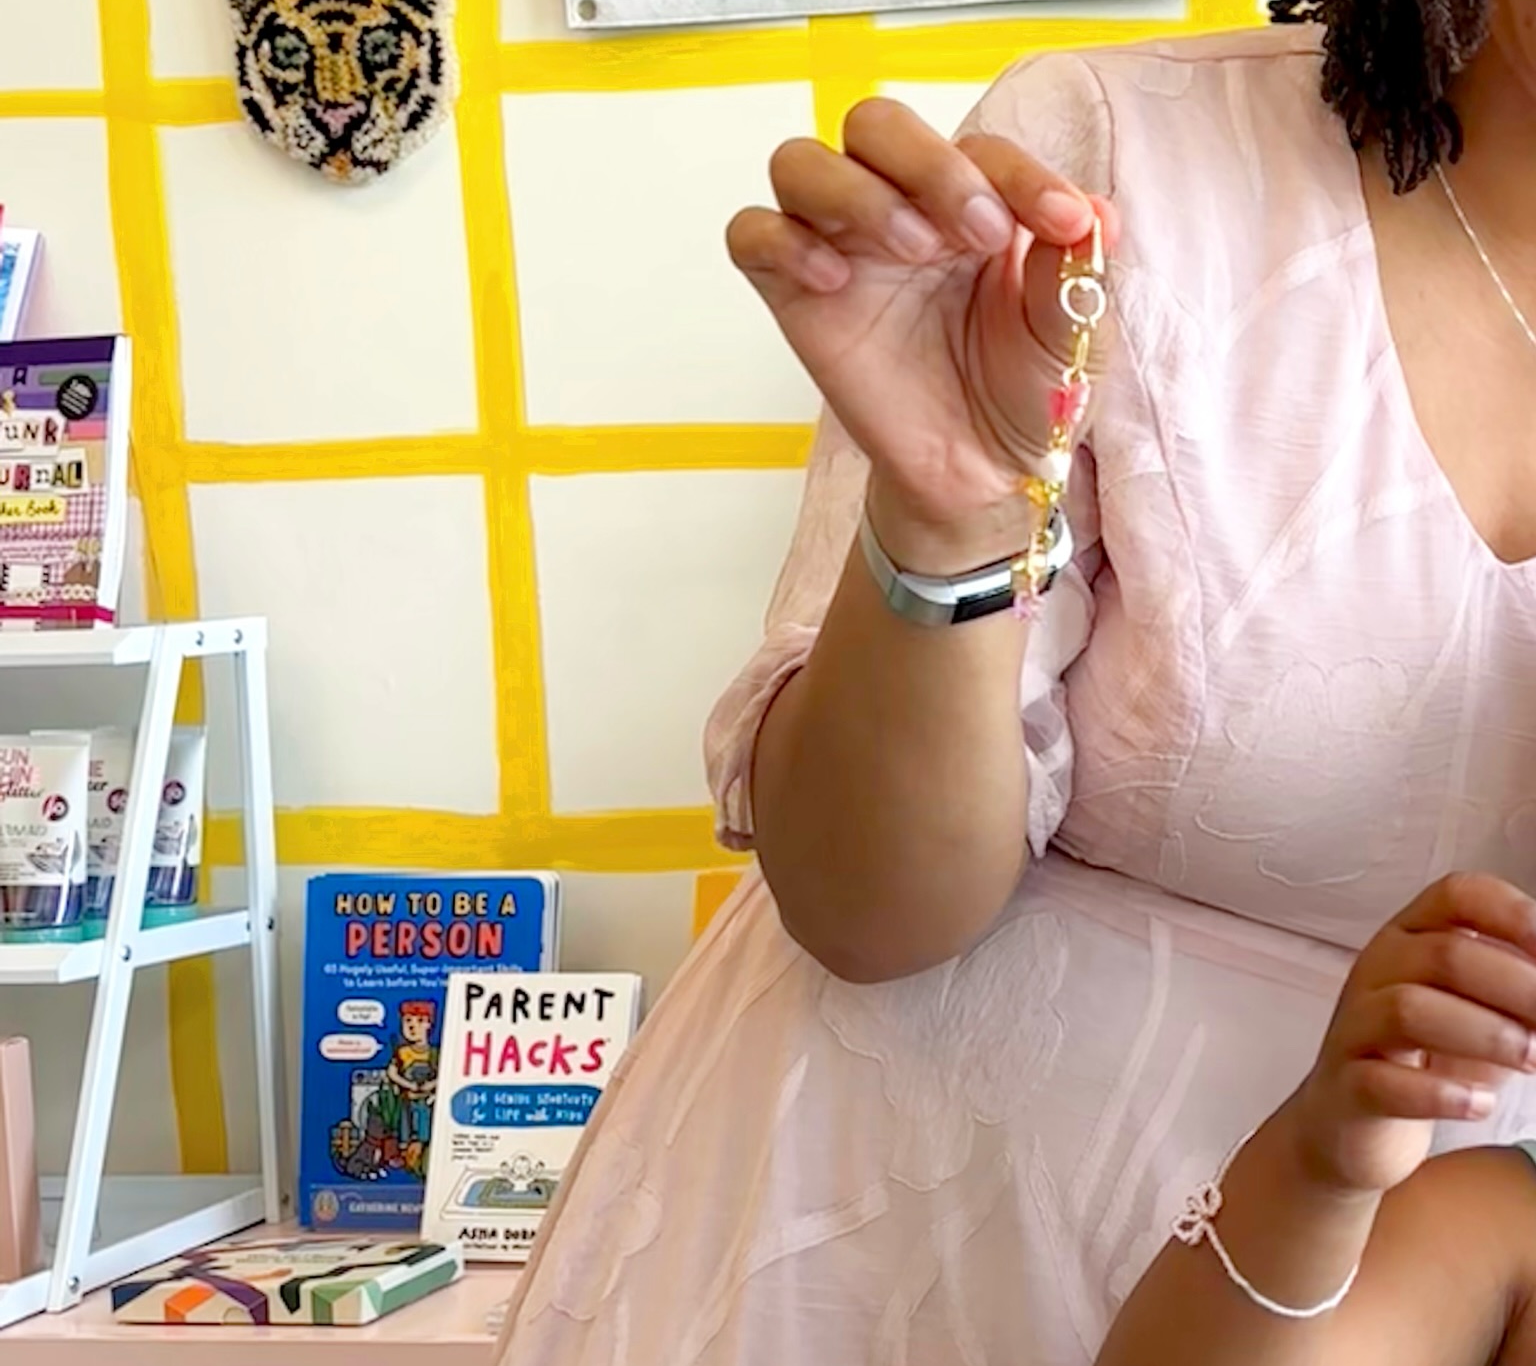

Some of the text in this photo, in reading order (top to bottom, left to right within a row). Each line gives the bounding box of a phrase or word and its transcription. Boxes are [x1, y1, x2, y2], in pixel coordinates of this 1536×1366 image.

[335, 891, 517, 916] HOW TO BE A
[346, 920, 504, 958] PERSON
[464, 982, 615, 1024] PARENT
[463, 1030, 606, 1076] HACKS
